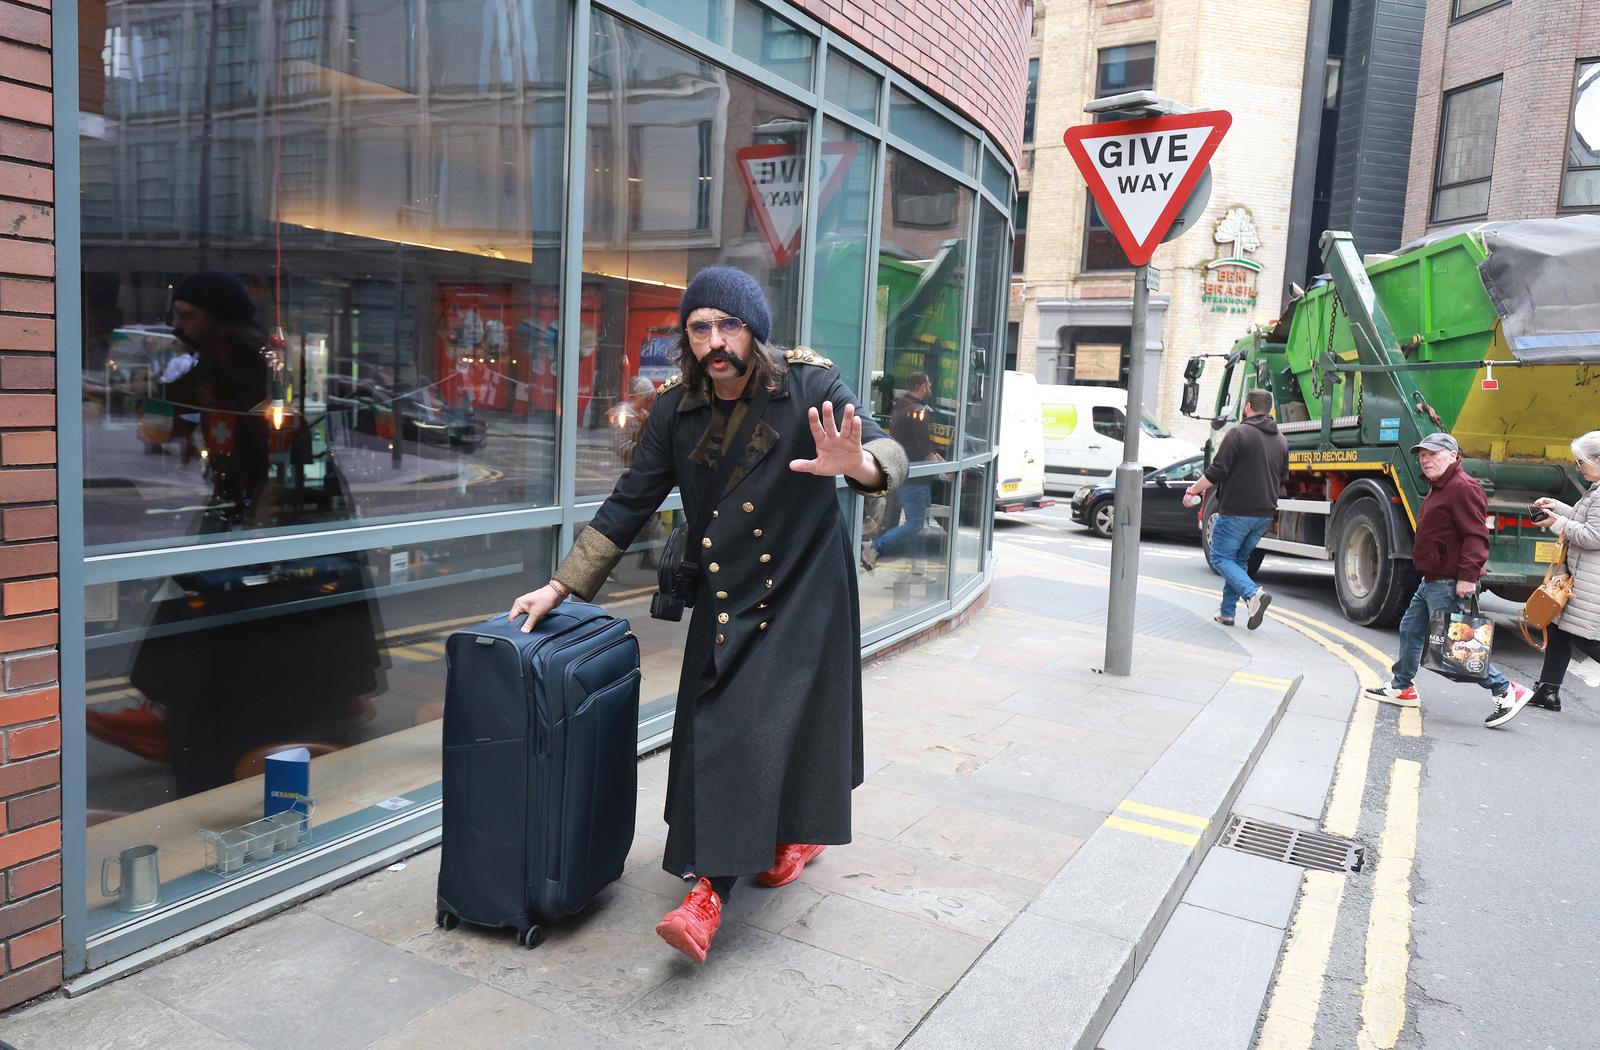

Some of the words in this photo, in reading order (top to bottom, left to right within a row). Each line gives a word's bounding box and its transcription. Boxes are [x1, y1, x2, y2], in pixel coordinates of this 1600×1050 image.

[1098, 134, 1188, 168] GIVE
[1118, 172, 1173, 194] WAY
[1210, 305, 1228, 313] AND
[1313, 452, 1321, 461] TO
[1322, 450, 1357, 461] RECYCLING
[1429, 634, 1445, 643] M&S
